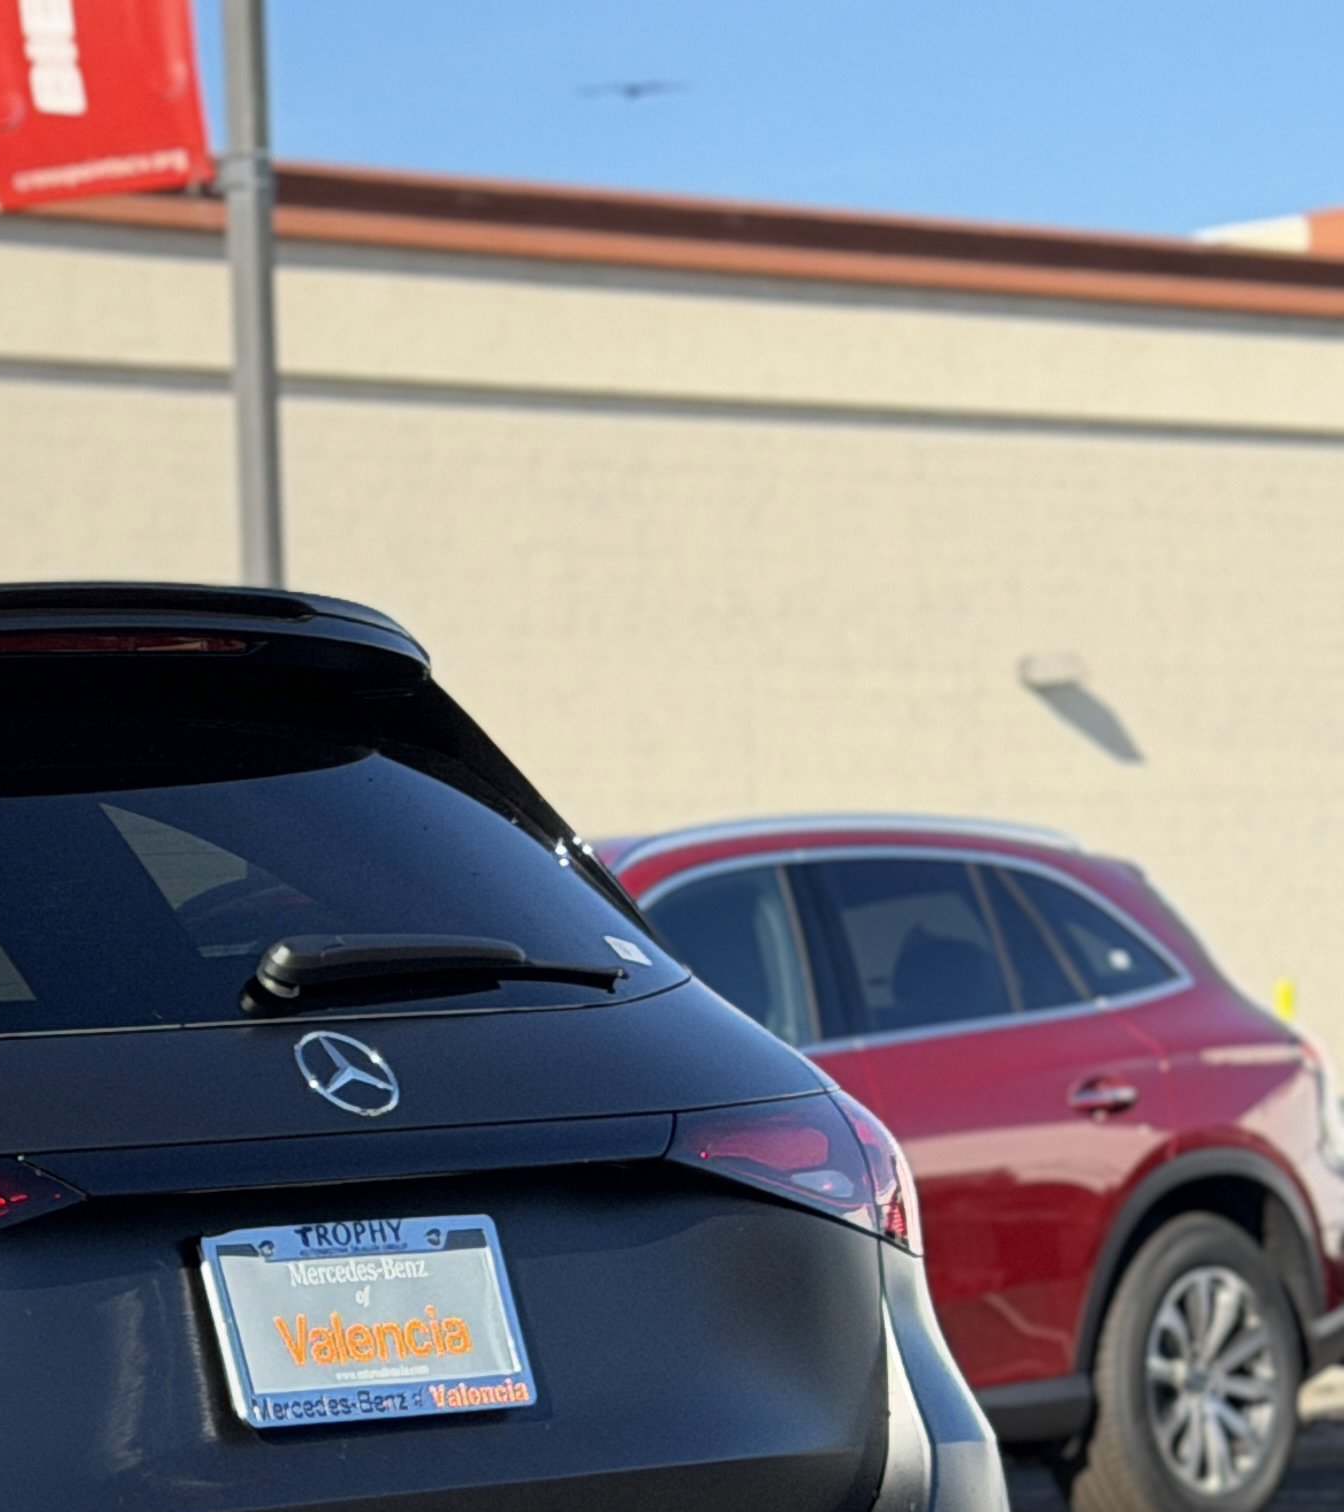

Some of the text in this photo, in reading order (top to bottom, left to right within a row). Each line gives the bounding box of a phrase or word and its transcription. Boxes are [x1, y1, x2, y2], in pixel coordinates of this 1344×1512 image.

[294, 1219, 403, 1247] TROPHY
[288, 1257, 429, 1287] Mercedes-Benz
[355, 1285, 371, 1308] of
[273, 1304, 473, 1367] Valencia
[251, 1389, 409, 1422] Mercedes-Benz
[427, 1377, 529, 1409] Valencia
